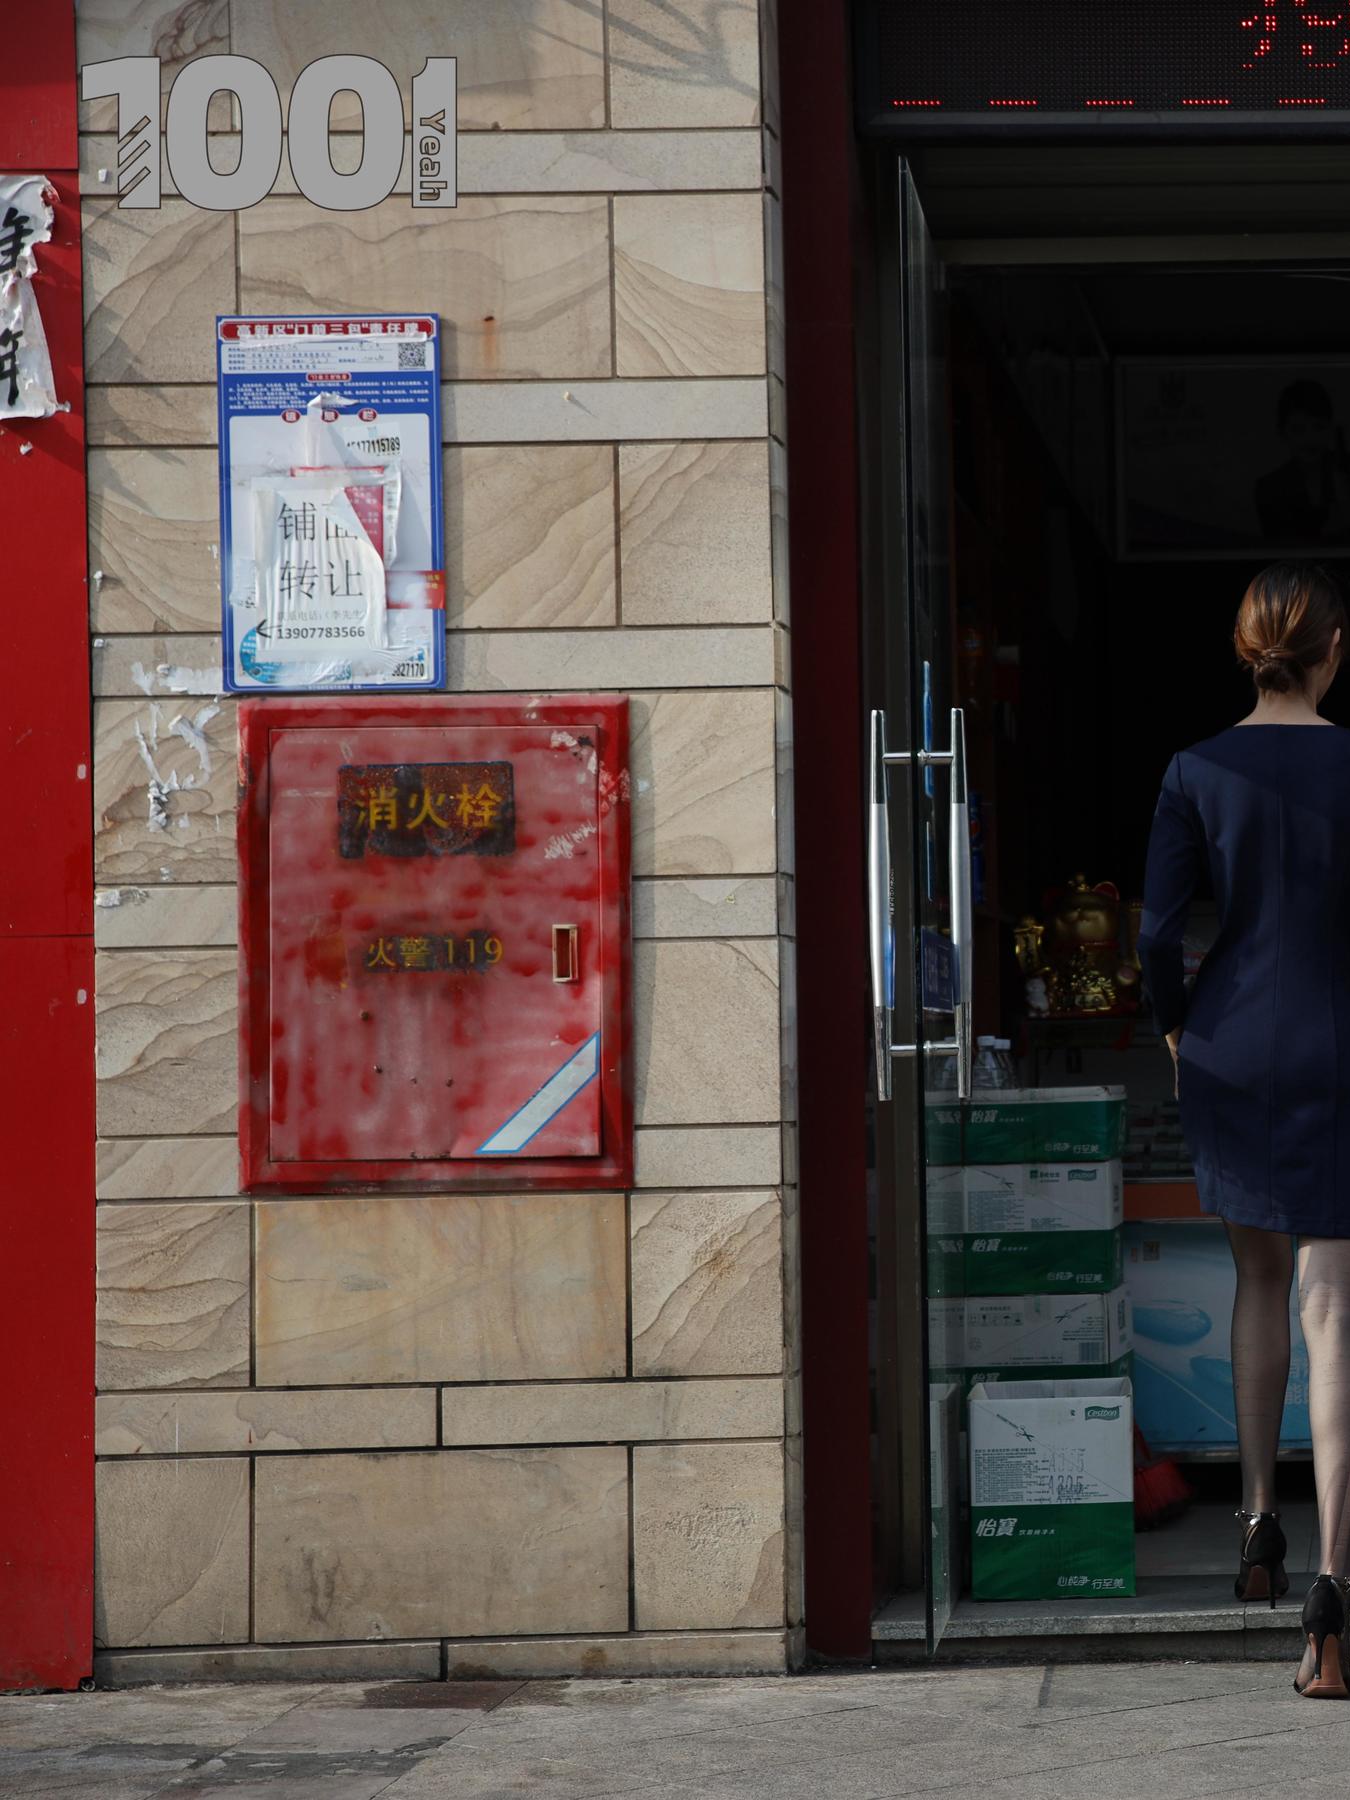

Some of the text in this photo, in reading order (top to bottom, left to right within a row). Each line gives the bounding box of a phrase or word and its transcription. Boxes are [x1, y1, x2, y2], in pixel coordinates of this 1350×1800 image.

[279, 559, 364, 600] 转让
[277, 626, 366, 640] 13907783566
[354, 782, 503, 832] 消火栓
[366, 937, 504, 969] 火警 119
